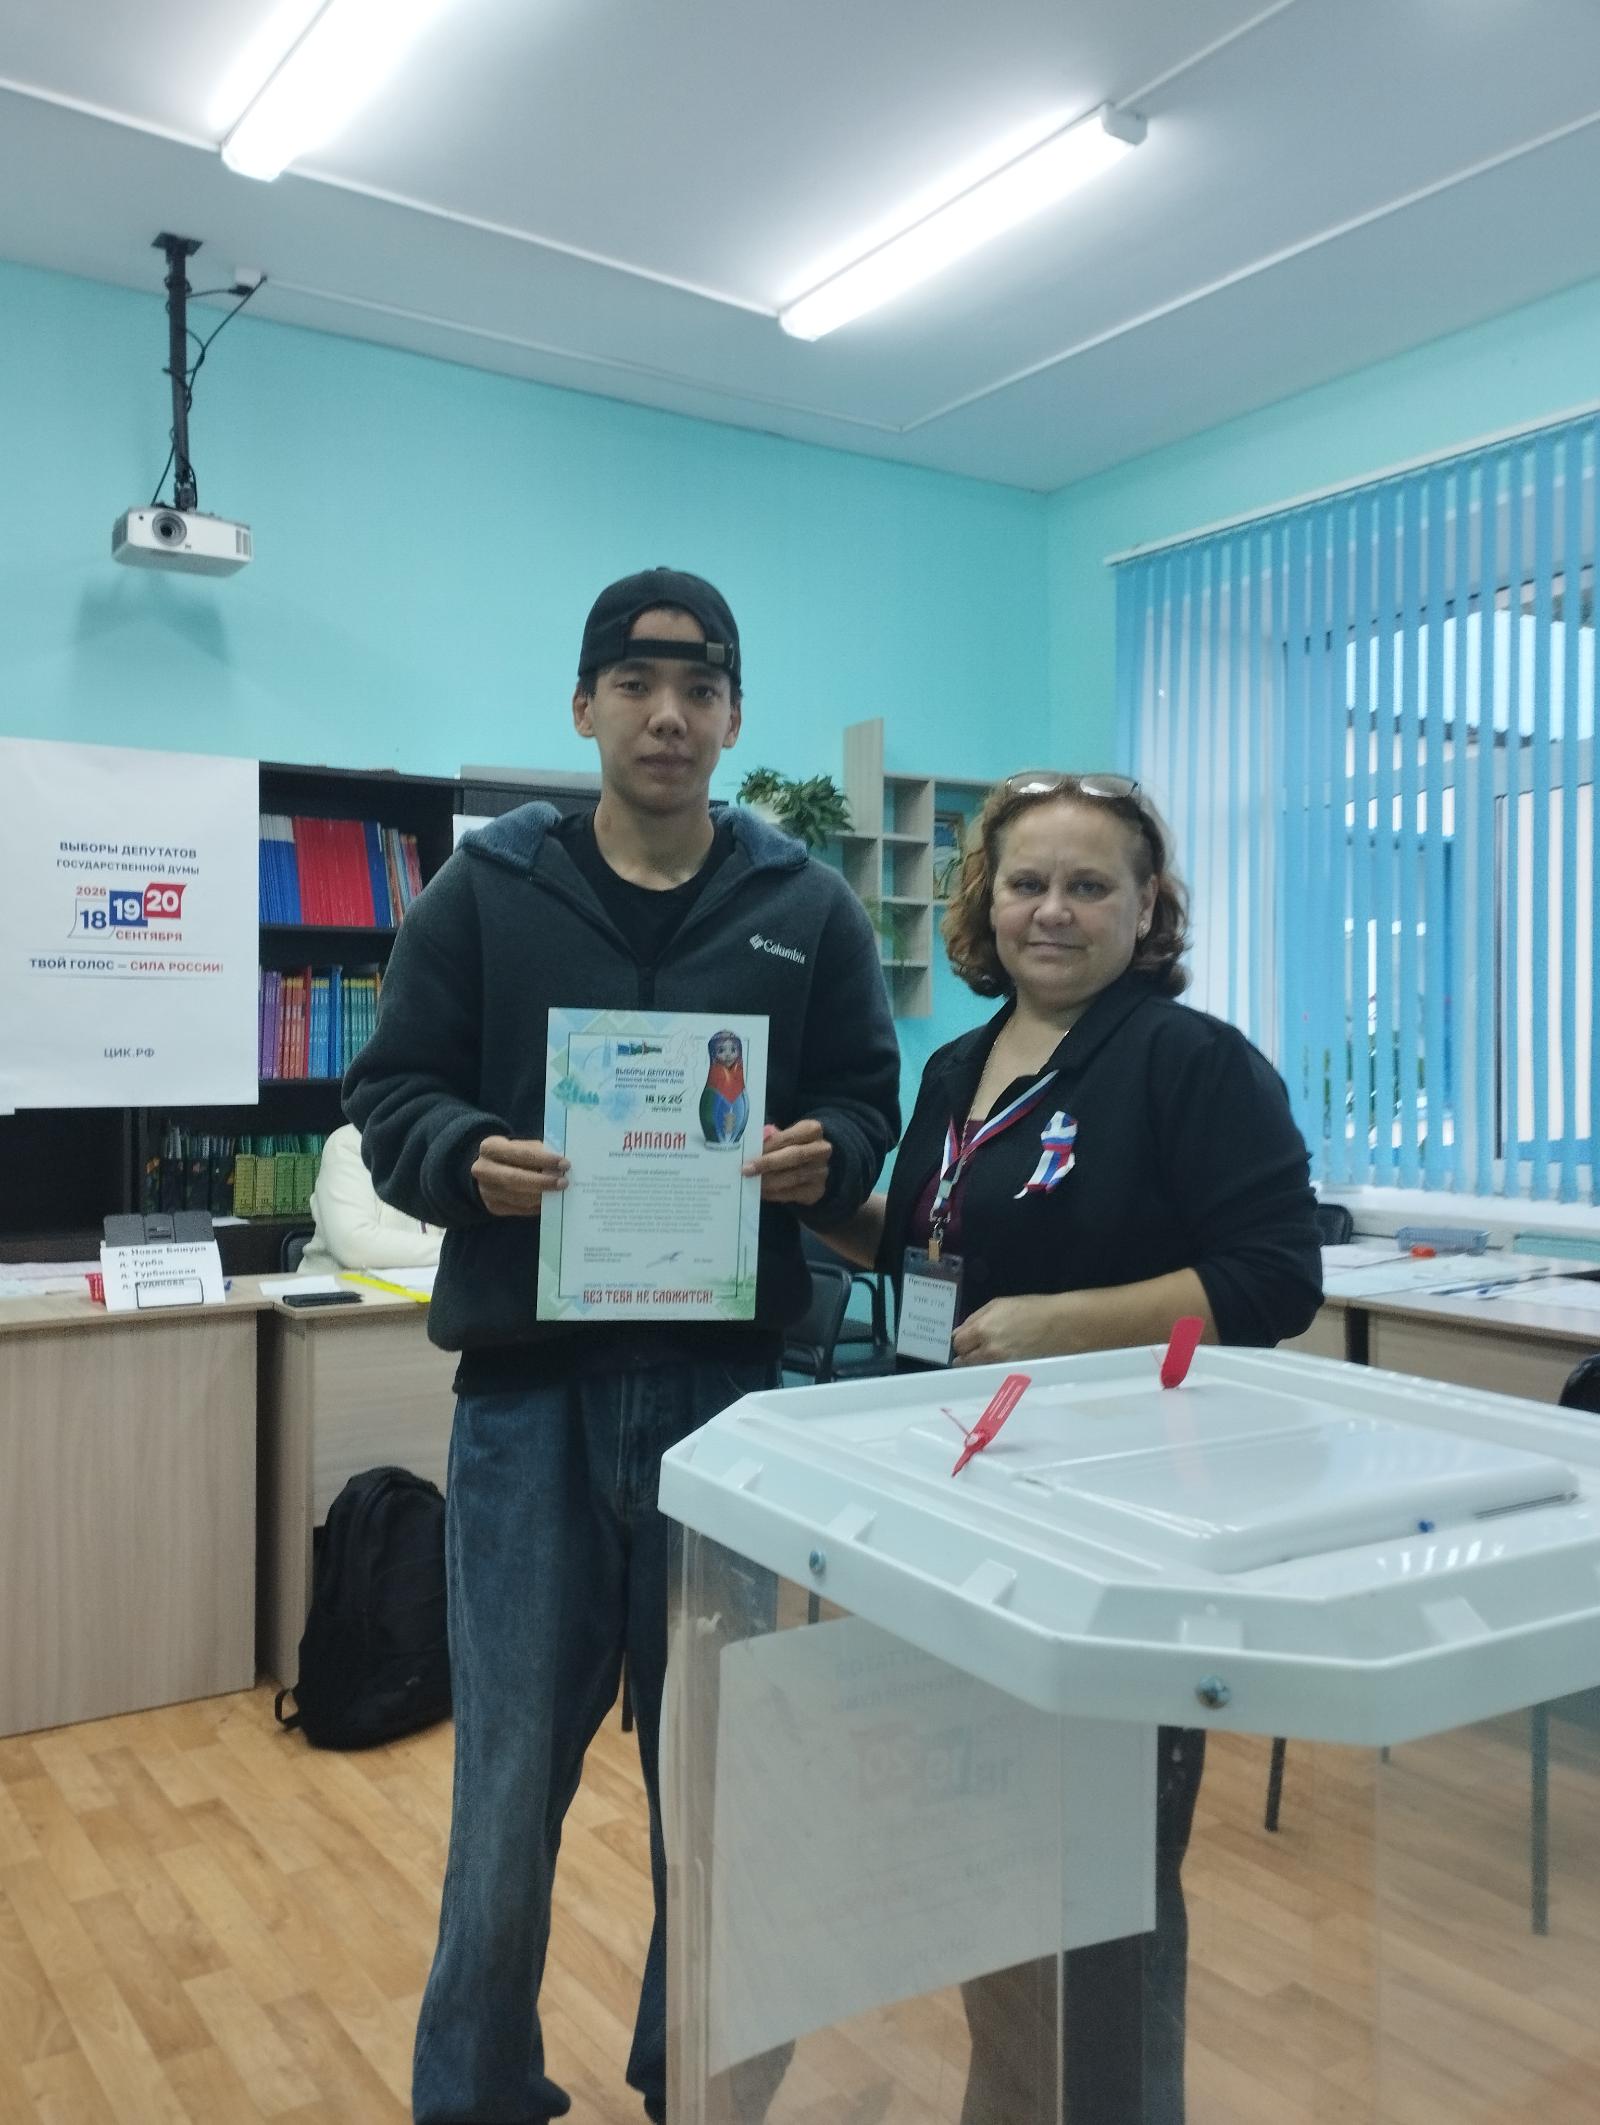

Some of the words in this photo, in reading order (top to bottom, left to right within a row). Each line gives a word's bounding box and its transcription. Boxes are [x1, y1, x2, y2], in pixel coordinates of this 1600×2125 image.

[59, 842, 118, 854] ВЫБОРЫ
[121, 845, 197, 859] ДЕПУТАТОВ
[56, 859, 165, 874] ГОСУДАРСТВЕННОЙ
[168, 864, 200, 875] ДУМЫ
[76, 886, 107, 897] 2026
[79, 910, 107, 930] 18
[112, 898, 141, 921] 19
[146, 889, 179, 913] 20
[115, 931, 182, 942] СЕНТЯБРЯ
[763, 938, 807, 965] Columbia
[30, 957, 67, 970] ТВОЙ
[70, 960, 115, 970] ГОЛОС
[130, 961, 165, 972] СИЛА
[168, 962, 224, 973] РОССИИ!
[104, 1047, 155, 1060] ЦИК.РФ
[622, 1131, 686, 1151] ДИПЛОМ
